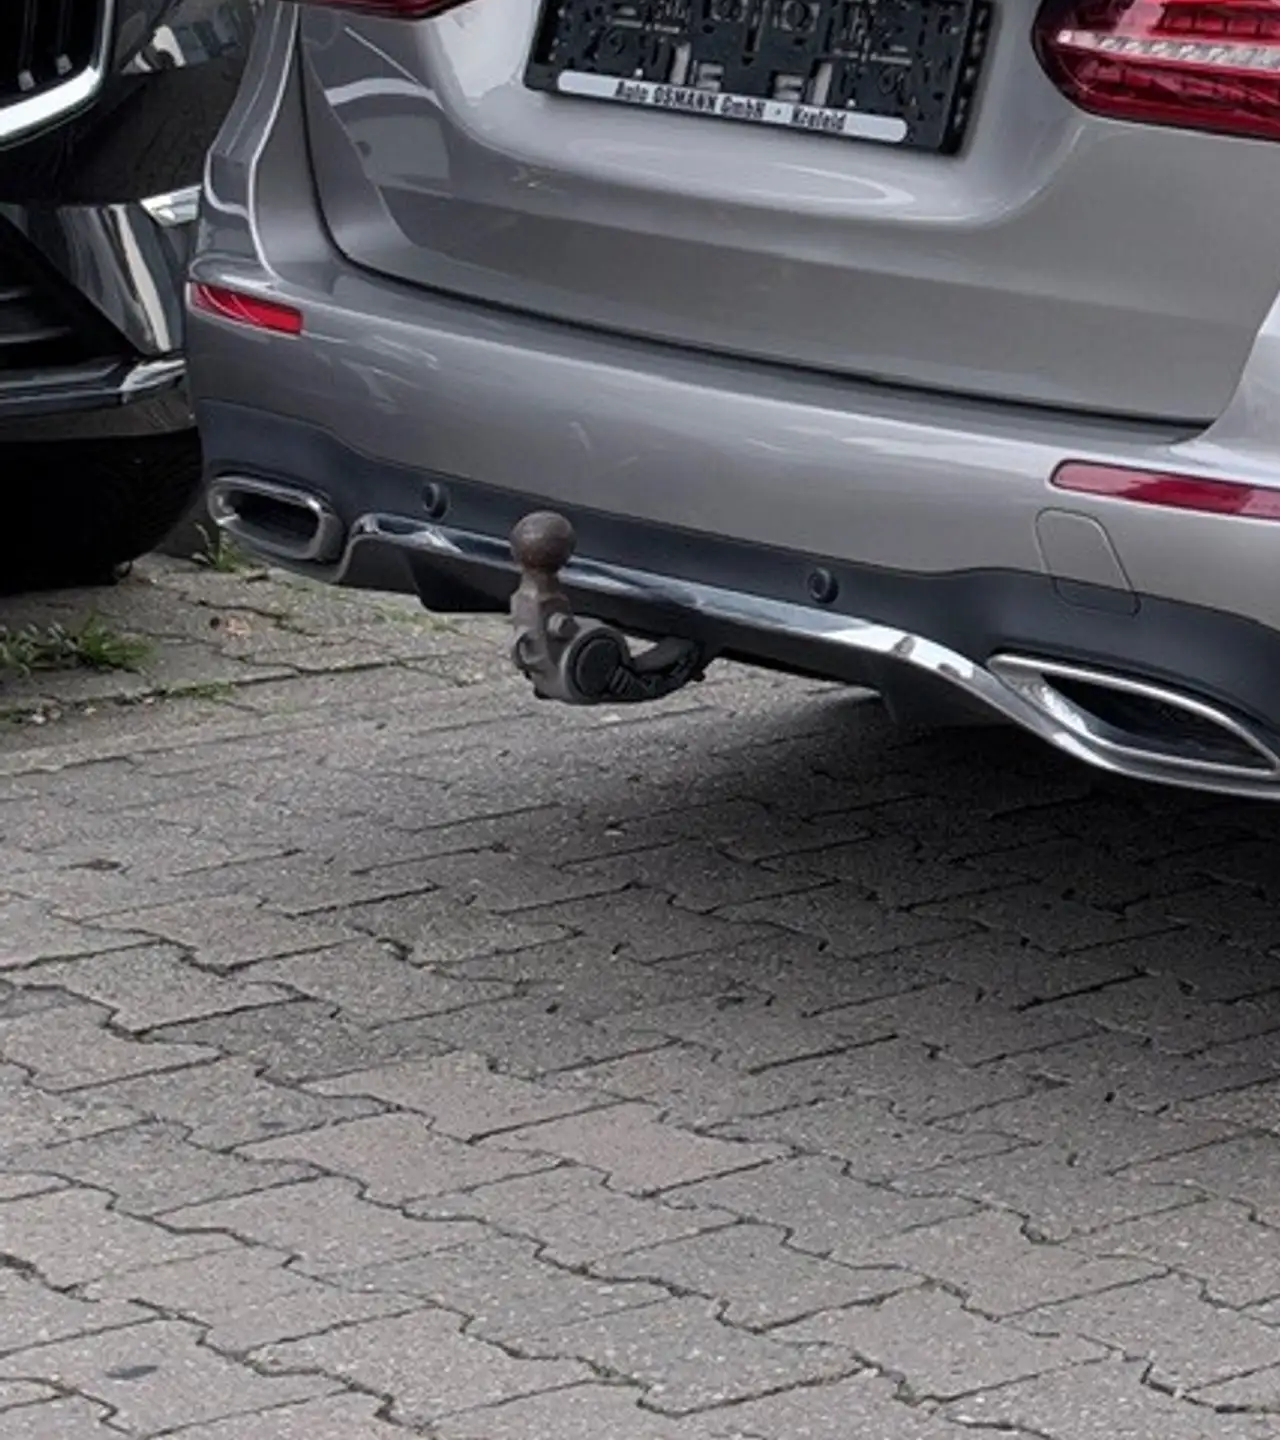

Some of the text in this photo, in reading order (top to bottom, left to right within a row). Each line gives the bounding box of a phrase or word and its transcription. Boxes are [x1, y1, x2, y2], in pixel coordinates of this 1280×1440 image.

[614, 80, 848, 132] Auto OSMANN GmbH Krefeld
